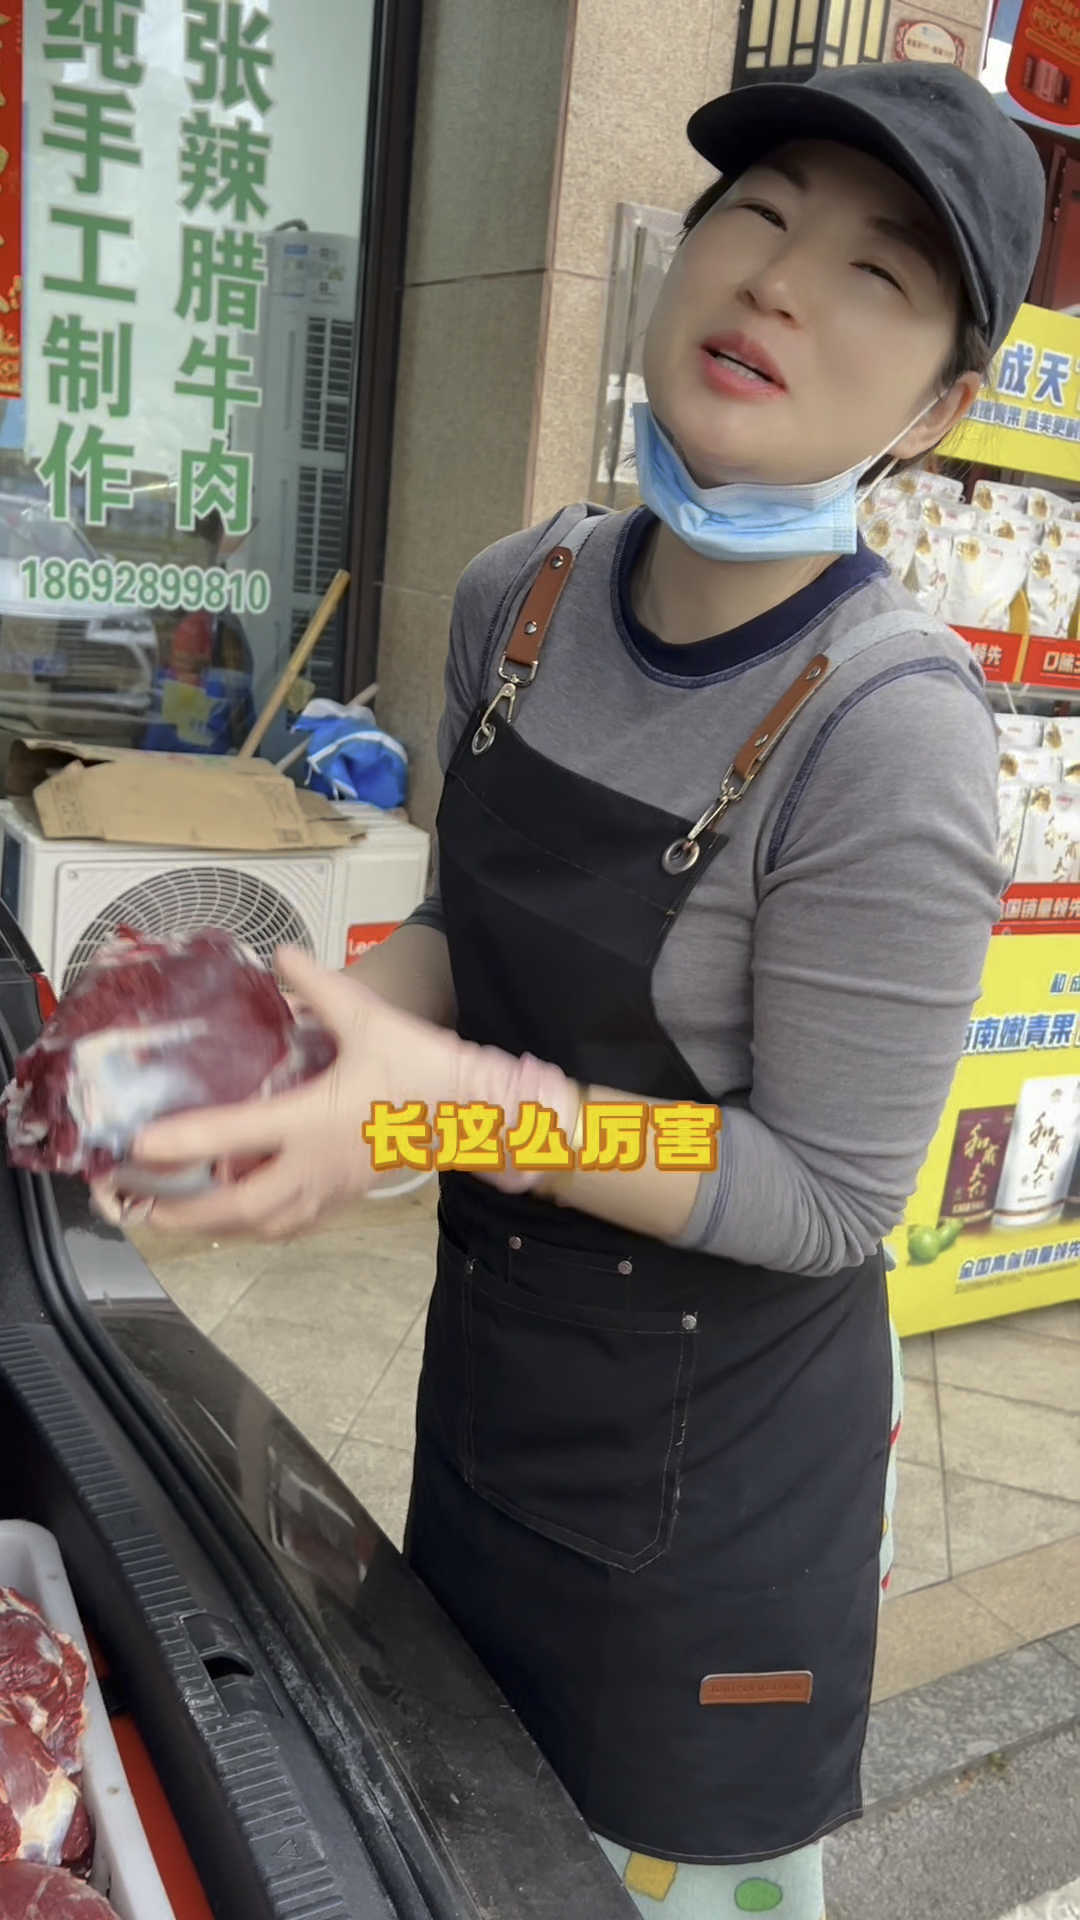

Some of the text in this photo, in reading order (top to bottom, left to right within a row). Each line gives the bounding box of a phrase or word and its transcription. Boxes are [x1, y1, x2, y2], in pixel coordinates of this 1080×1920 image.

[37, 0, 144, 526] 纯手工制作
[174, 0, 275, 536] 张辣腊牛肉
[997, 340, 1080, 408] 成天
[20, 556, 271, 614] 18692899810
